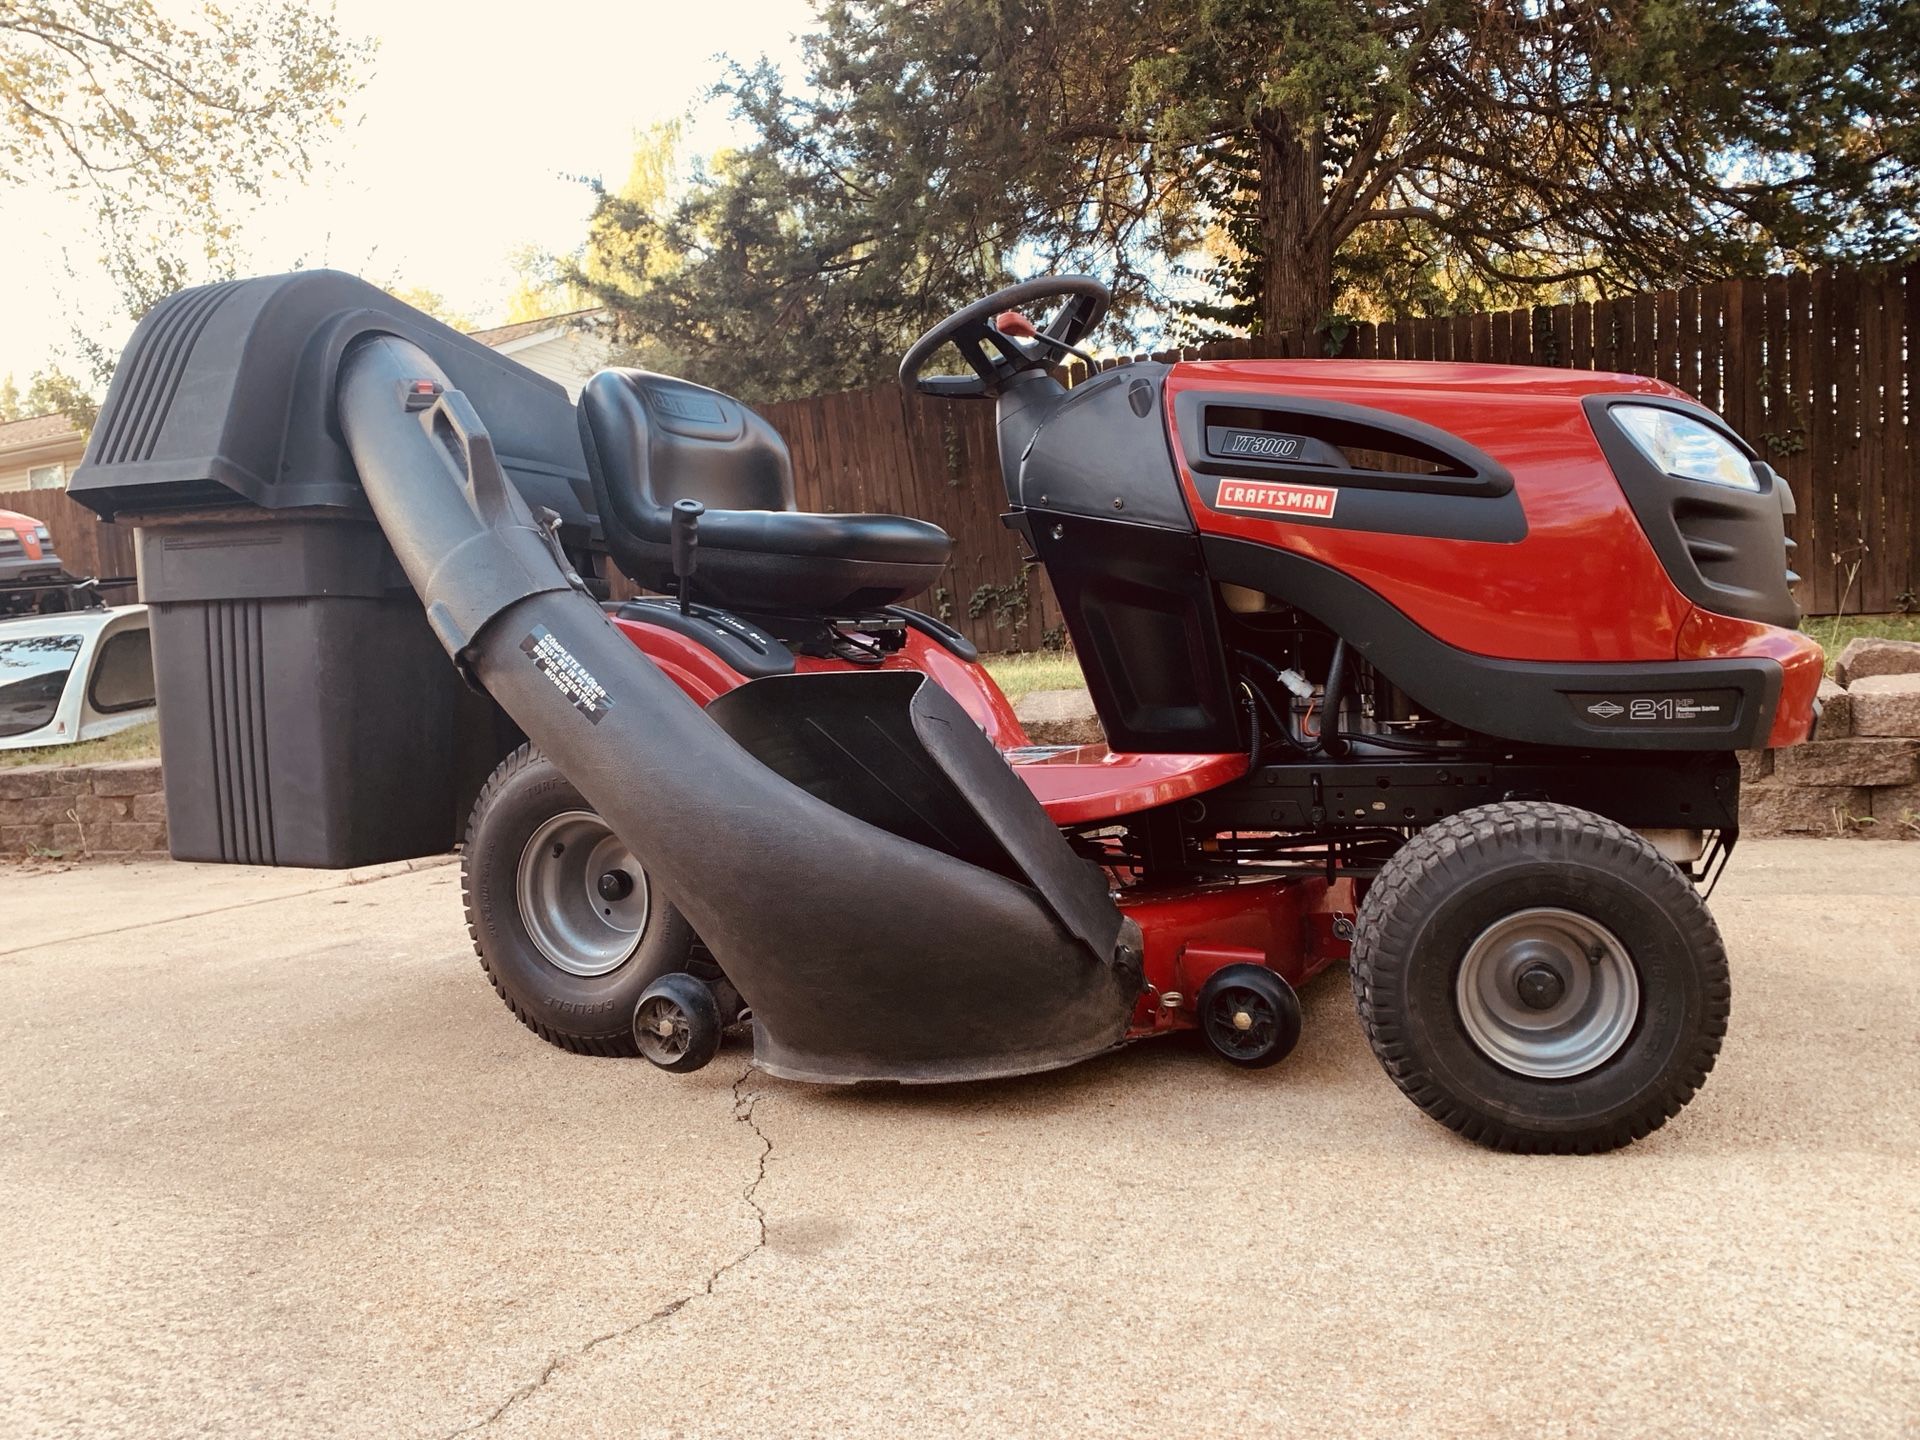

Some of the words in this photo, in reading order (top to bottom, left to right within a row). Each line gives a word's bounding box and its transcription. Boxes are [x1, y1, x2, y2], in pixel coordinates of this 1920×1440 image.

[1224, 486, 1328, 510] CRAFTSMAN
[533, 645, 560, 673] BEFORE
[558, 671, 597, 712] OPERATING
[538, 639, 559, 660] MUST
[556, 658, 569, 671] BE
[566, 668, 577, 679] IN
[575, 677, 598, 702] PLACE
[544, 634, 581, 670] COMPLETE
[577, 668, 606, 698] BAGGER
[544, 668, 570, 695] MOWER
[1630, 698, 1673, 720] 21
